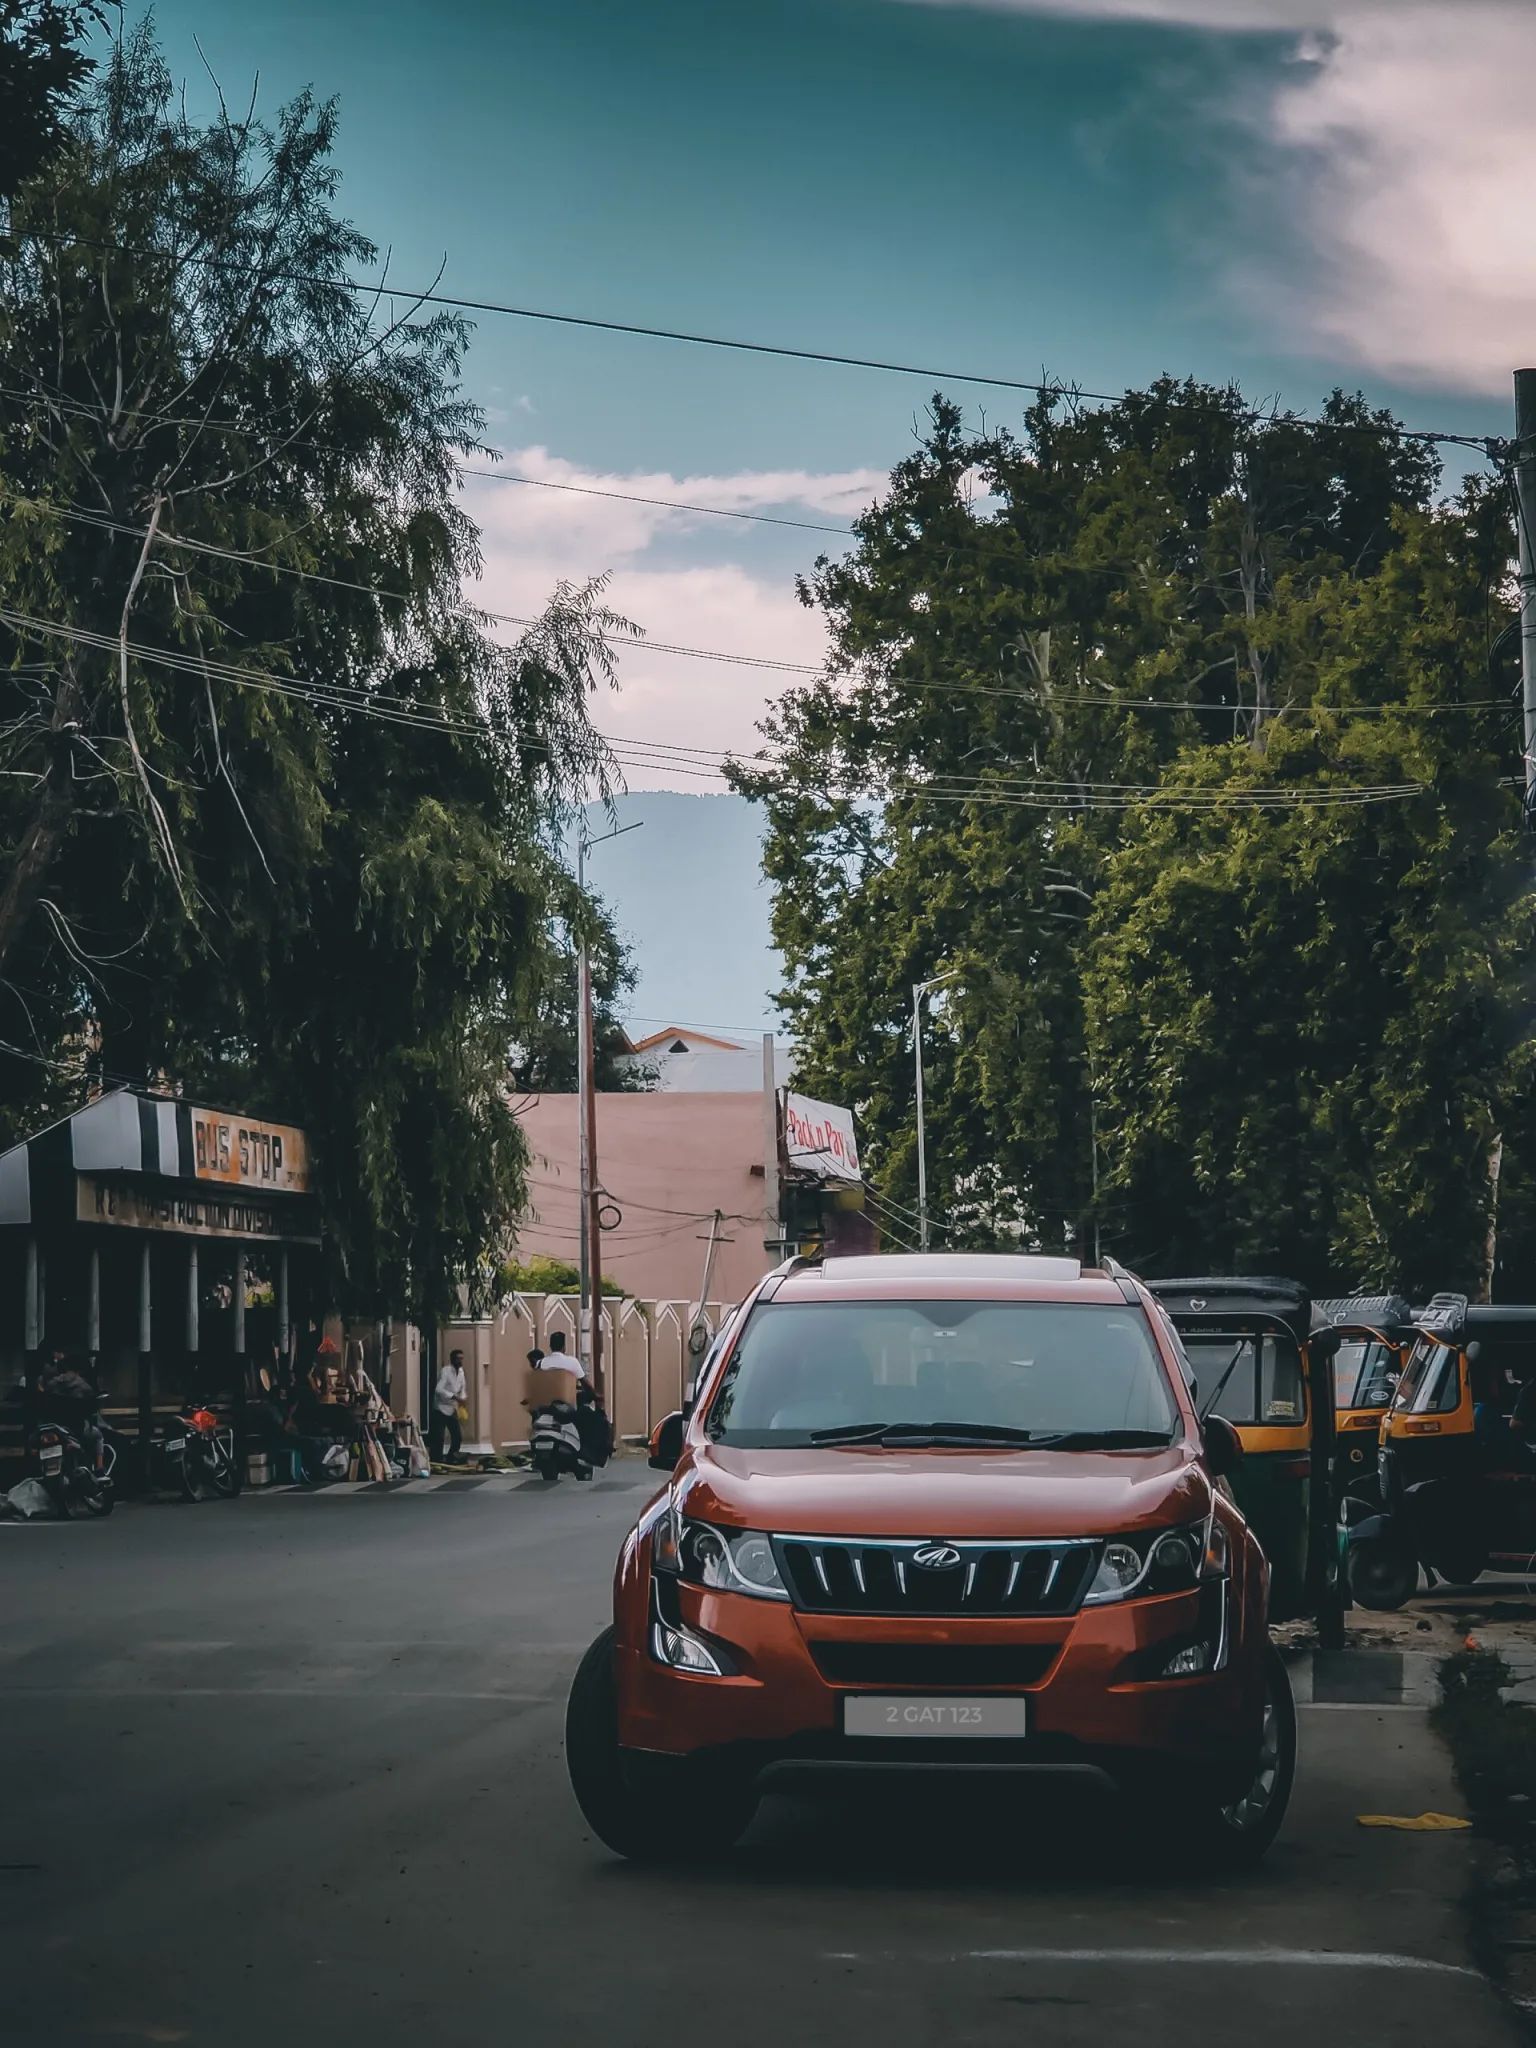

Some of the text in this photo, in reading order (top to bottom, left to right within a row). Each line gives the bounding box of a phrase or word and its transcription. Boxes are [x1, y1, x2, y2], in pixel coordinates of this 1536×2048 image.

[196, 1121, 283, 1181] BUS STOP
[824, 1120, 845, 1168] Pay
[886, 1706, 982, 1723] 2 GAT 123
